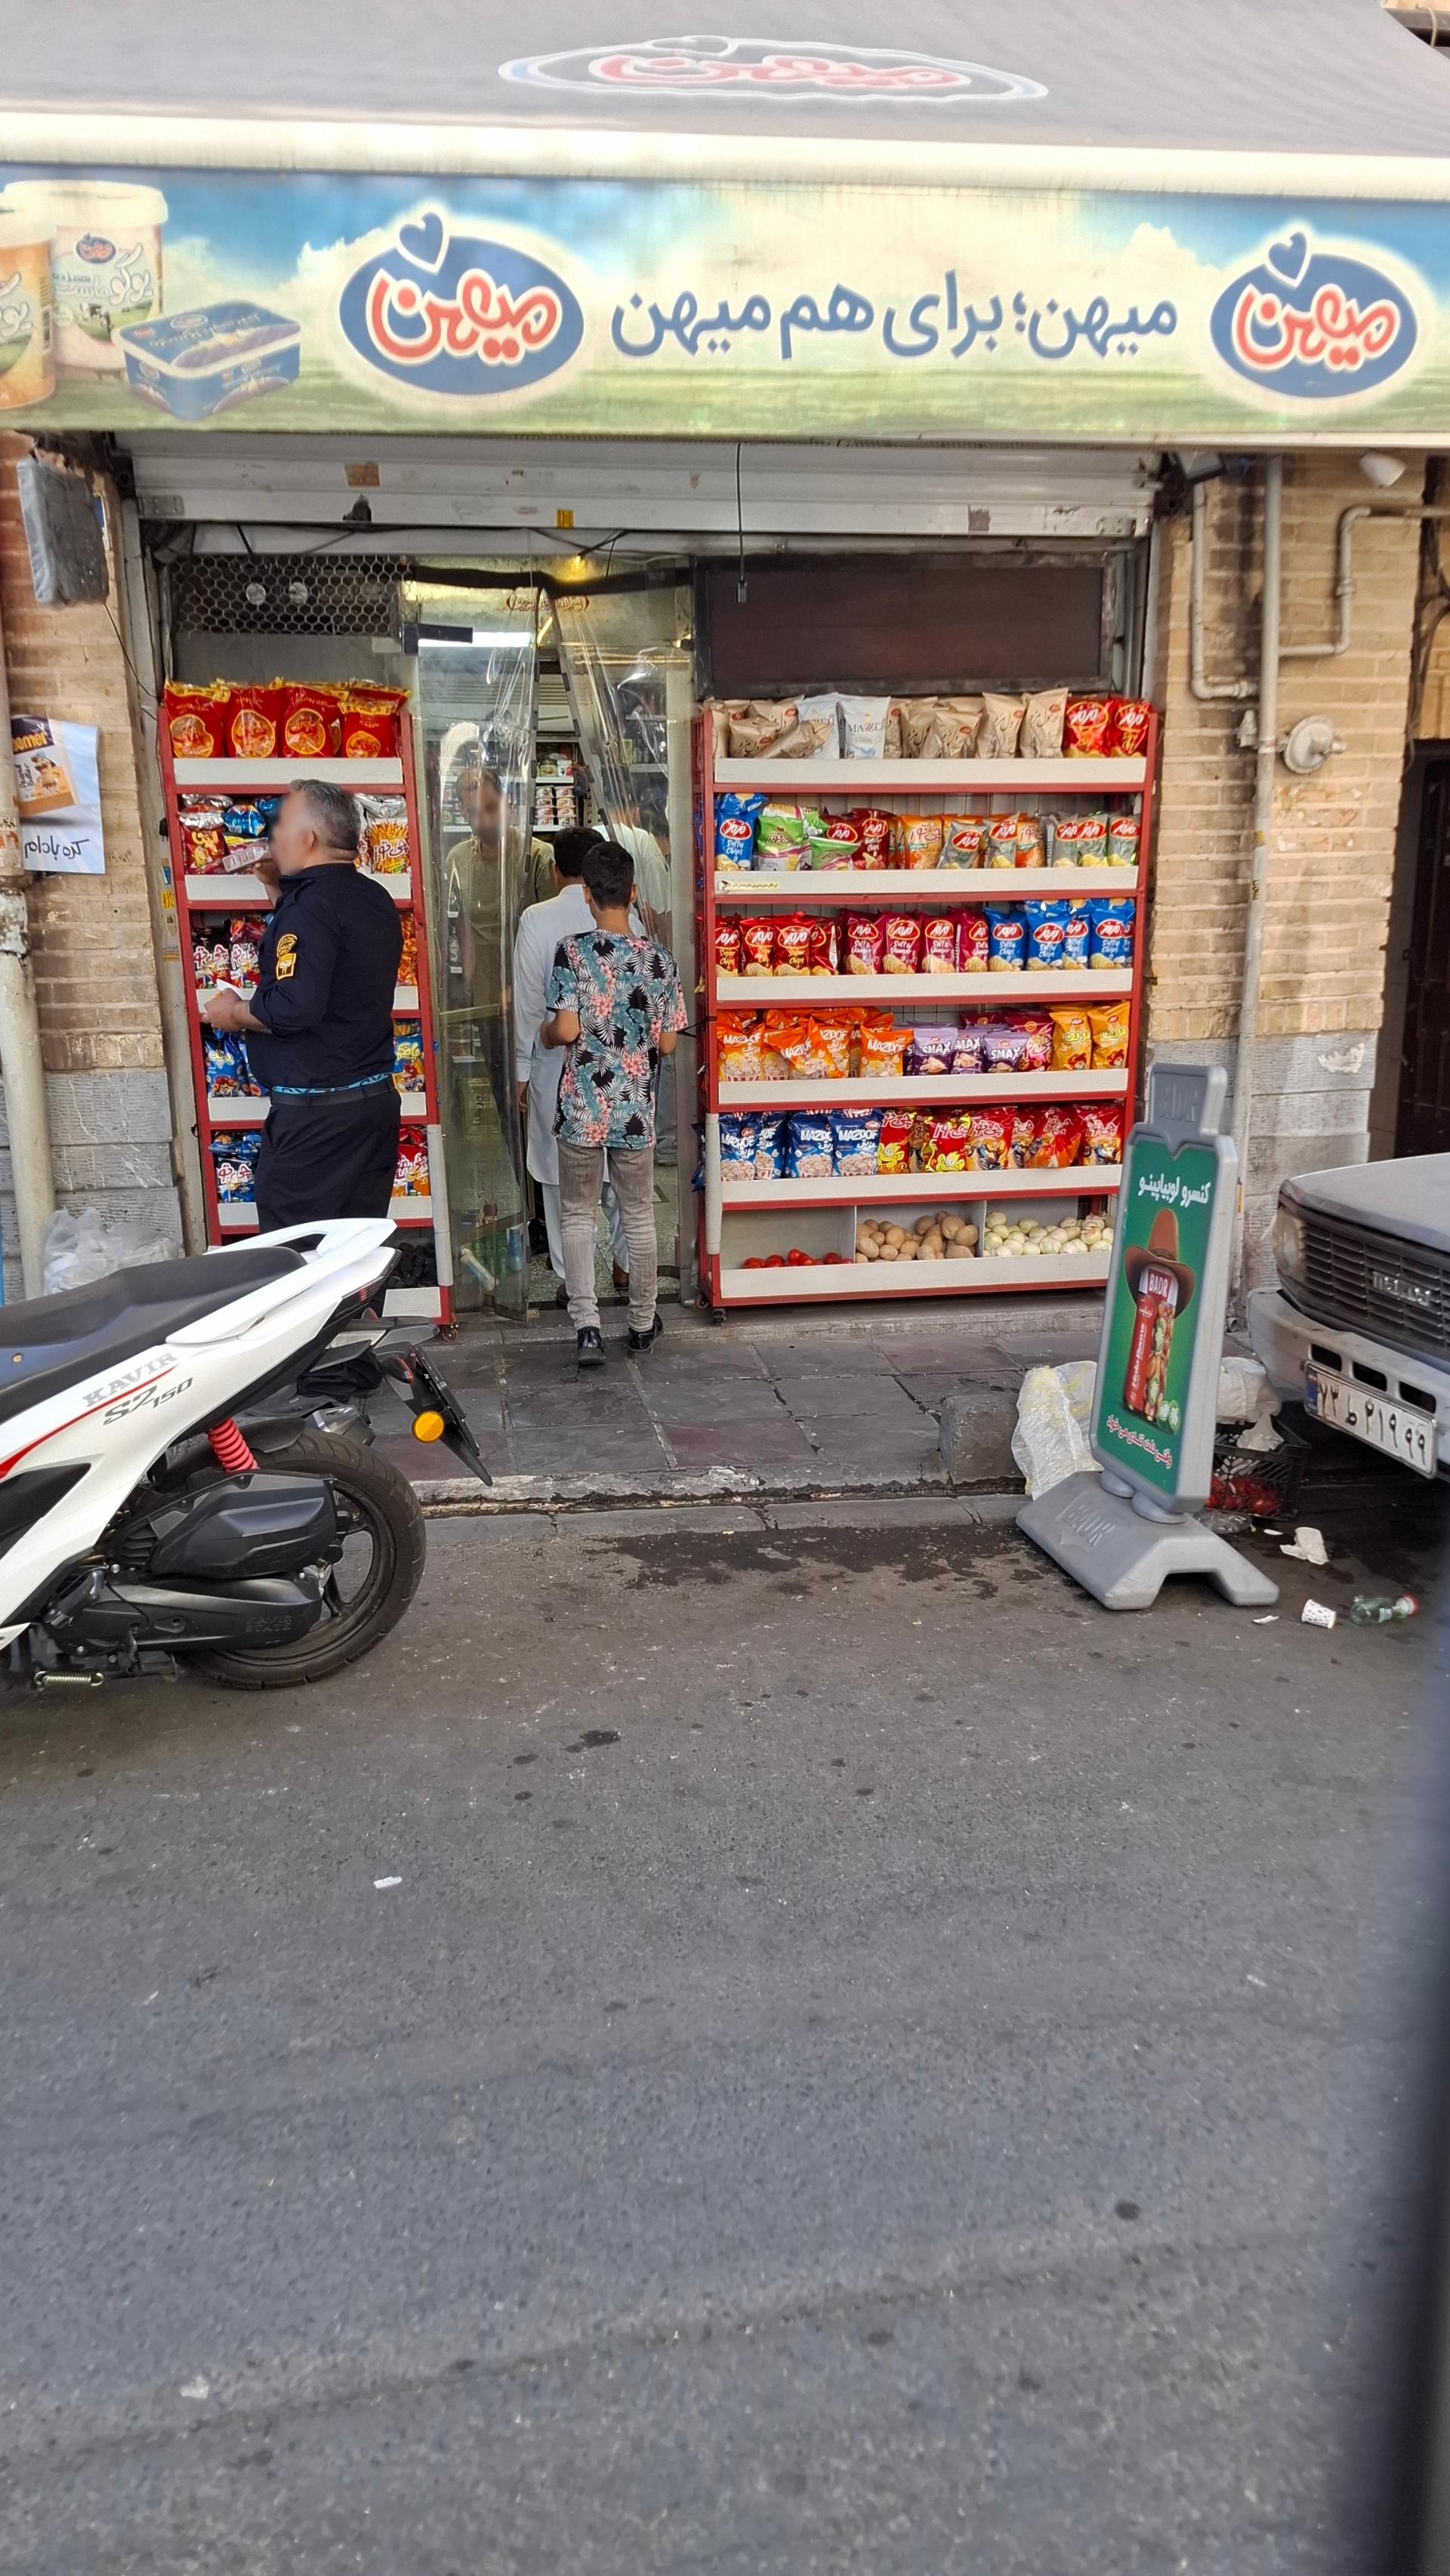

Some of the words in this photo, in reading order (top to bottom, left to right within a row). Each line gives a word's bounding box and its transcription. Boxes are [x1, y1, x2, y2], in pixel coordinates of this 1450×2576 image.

[368, 272, 560, 362] میهن
[780, 282, 874, 359] هم
[881, 270, 1003, 358] برای
[611, 291, 771, 357] میهن
[1234, 286, 1397, 369] میهن
[1071, 705, 1100, 726] مزمز
[725, 821, 747, 836] مزمز
[995, 821, 1016, 837] مزمز
[956, 831, 980, 847] مزمز
[784, 929, 808, 944] مزمز
[999, 925, 1017, 938] مزمز
[1038, 926, 1060, 941] مزمز
[1100, 923, 1121, 936] مزمز
[922, 1040, 952, 1055] SMAX
[991, 1046, 1021, 1060] SMAX
[1180, 1182, 1211, 1208] کنسرو
[1149, 1273, 1168, 1299] BADR
[83, 1352, 178, 1407] KAVIR
